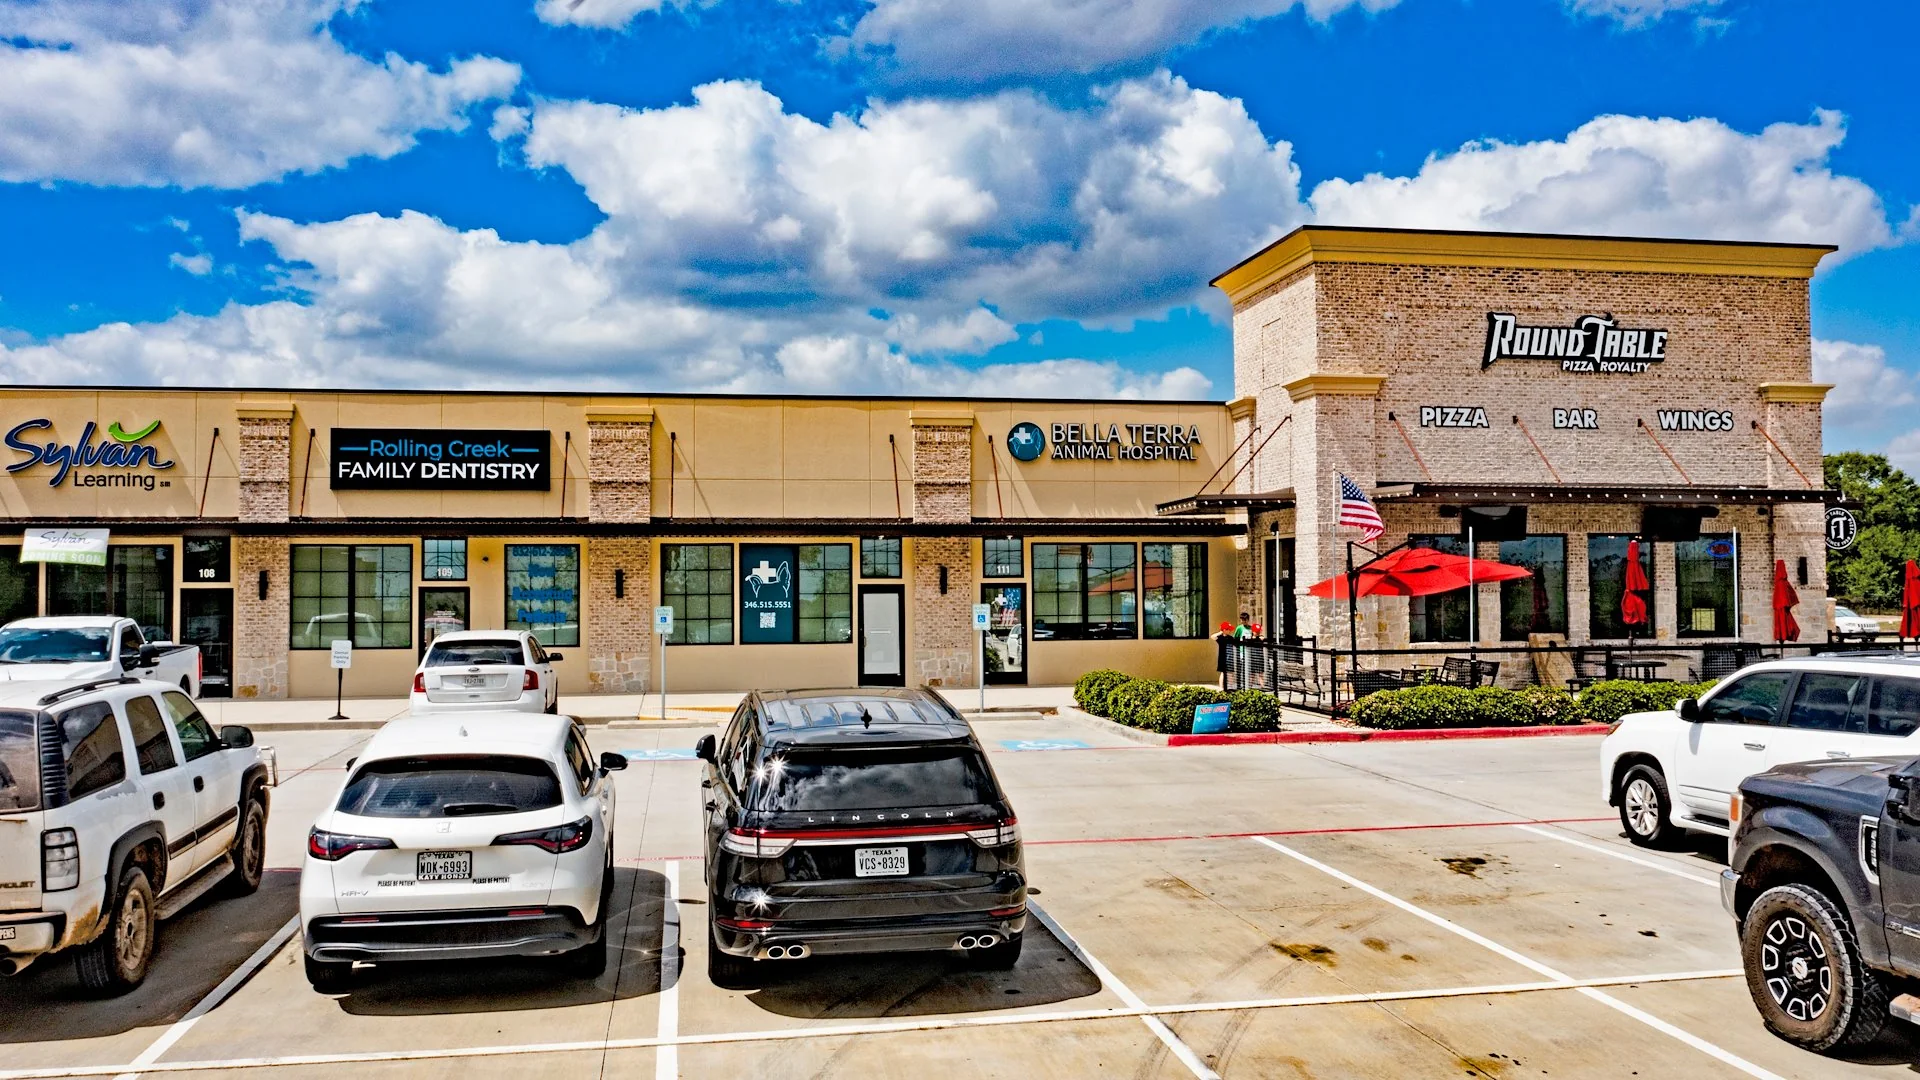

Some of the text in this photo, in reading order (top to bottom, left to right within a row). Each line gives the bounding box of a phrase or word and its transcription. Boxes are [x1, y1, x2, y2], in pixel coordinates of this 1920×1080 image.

[1562, 360, 1651, 372] PIZZA ROYALTY
[1420, 407, 1488, 427] PIZZA
[1553, 408, 1598, 428] BAR
[1658, 410, 1734, 431] WINGS
[1051, 423, 1201, 444] BELLA TERRA
[4, 418, 175, 487] Sylvan
[369, 439, 510, 461] Rolling Creek
[1051, 444, 1198, 460] ANIMAL HOSPITAL
[338, 461, 540, 480] FAMILY DENTISTRY
[74, 471, 155, 491] Learning
[40, 531, 91, 548] Sylvan
[71, 552, 102, 564] SOON
[198, 569, 215, 578] 108
[437, 568, 453, 577] 109
[997, 565, 1010, 574] 111
[744, 601, 792, 609] 346.515.5551
[808, 811, 953, 822] LINCOLN
